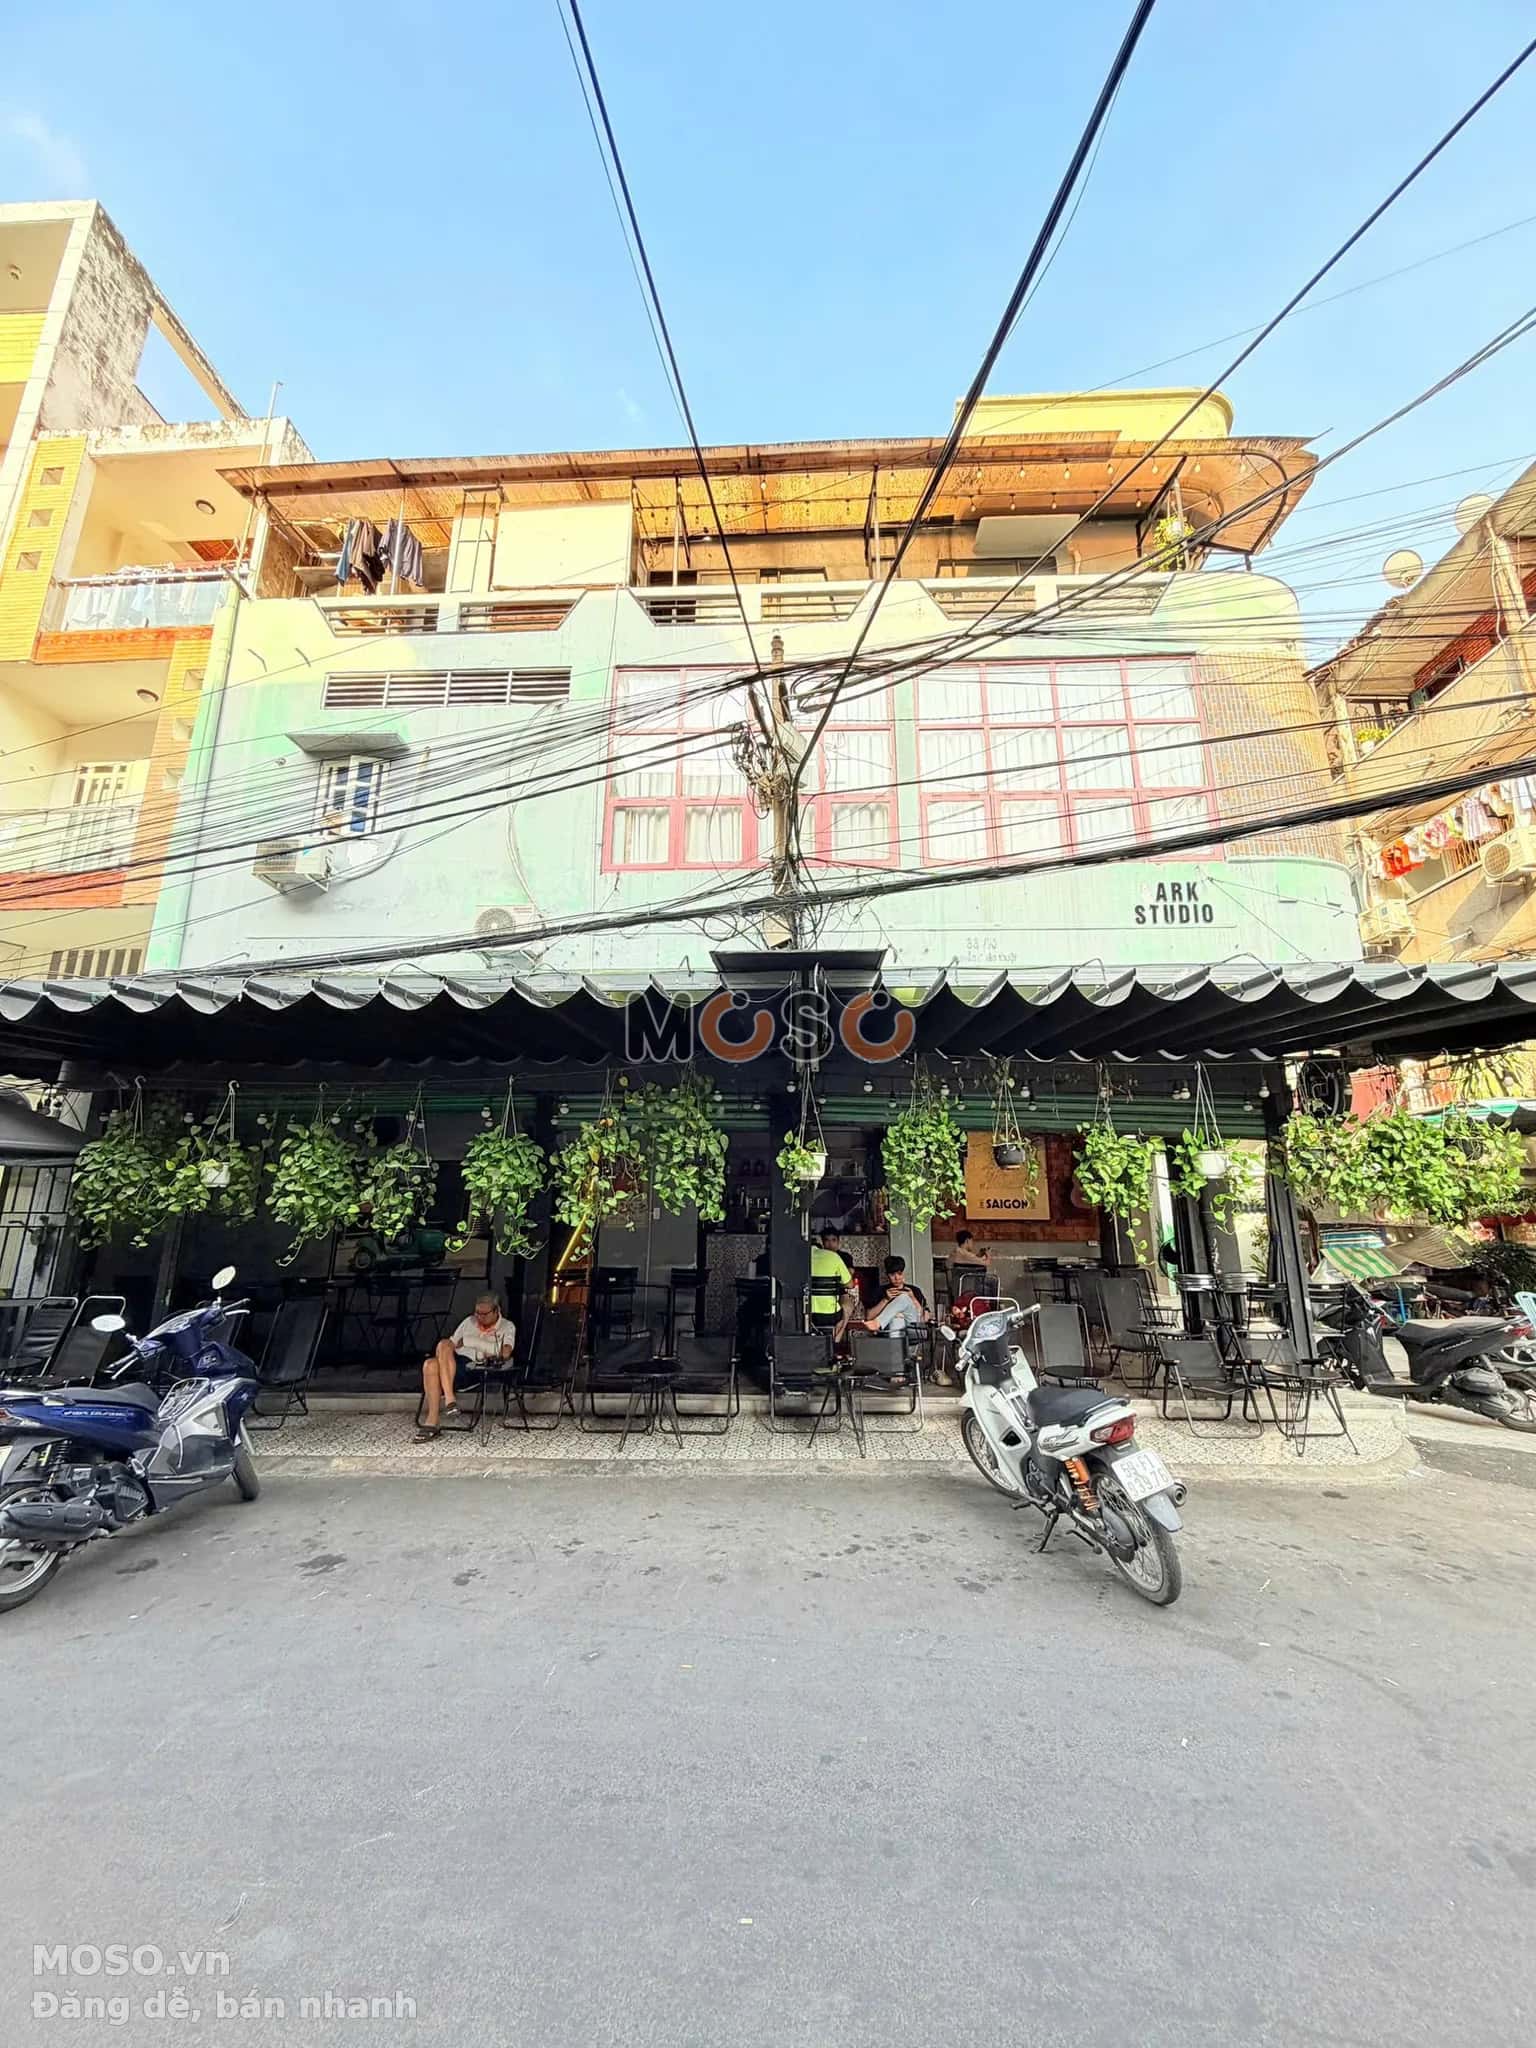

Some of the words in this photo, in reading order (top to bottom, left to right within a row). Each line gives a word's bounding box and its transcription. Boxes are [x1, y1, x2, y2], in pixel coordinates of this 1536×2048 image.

[1156, 882, 1198, 902] ARK
[1134, 904, 1214, 925] STUDIO
[986, 1199, 1028, 1209] SAIGON
